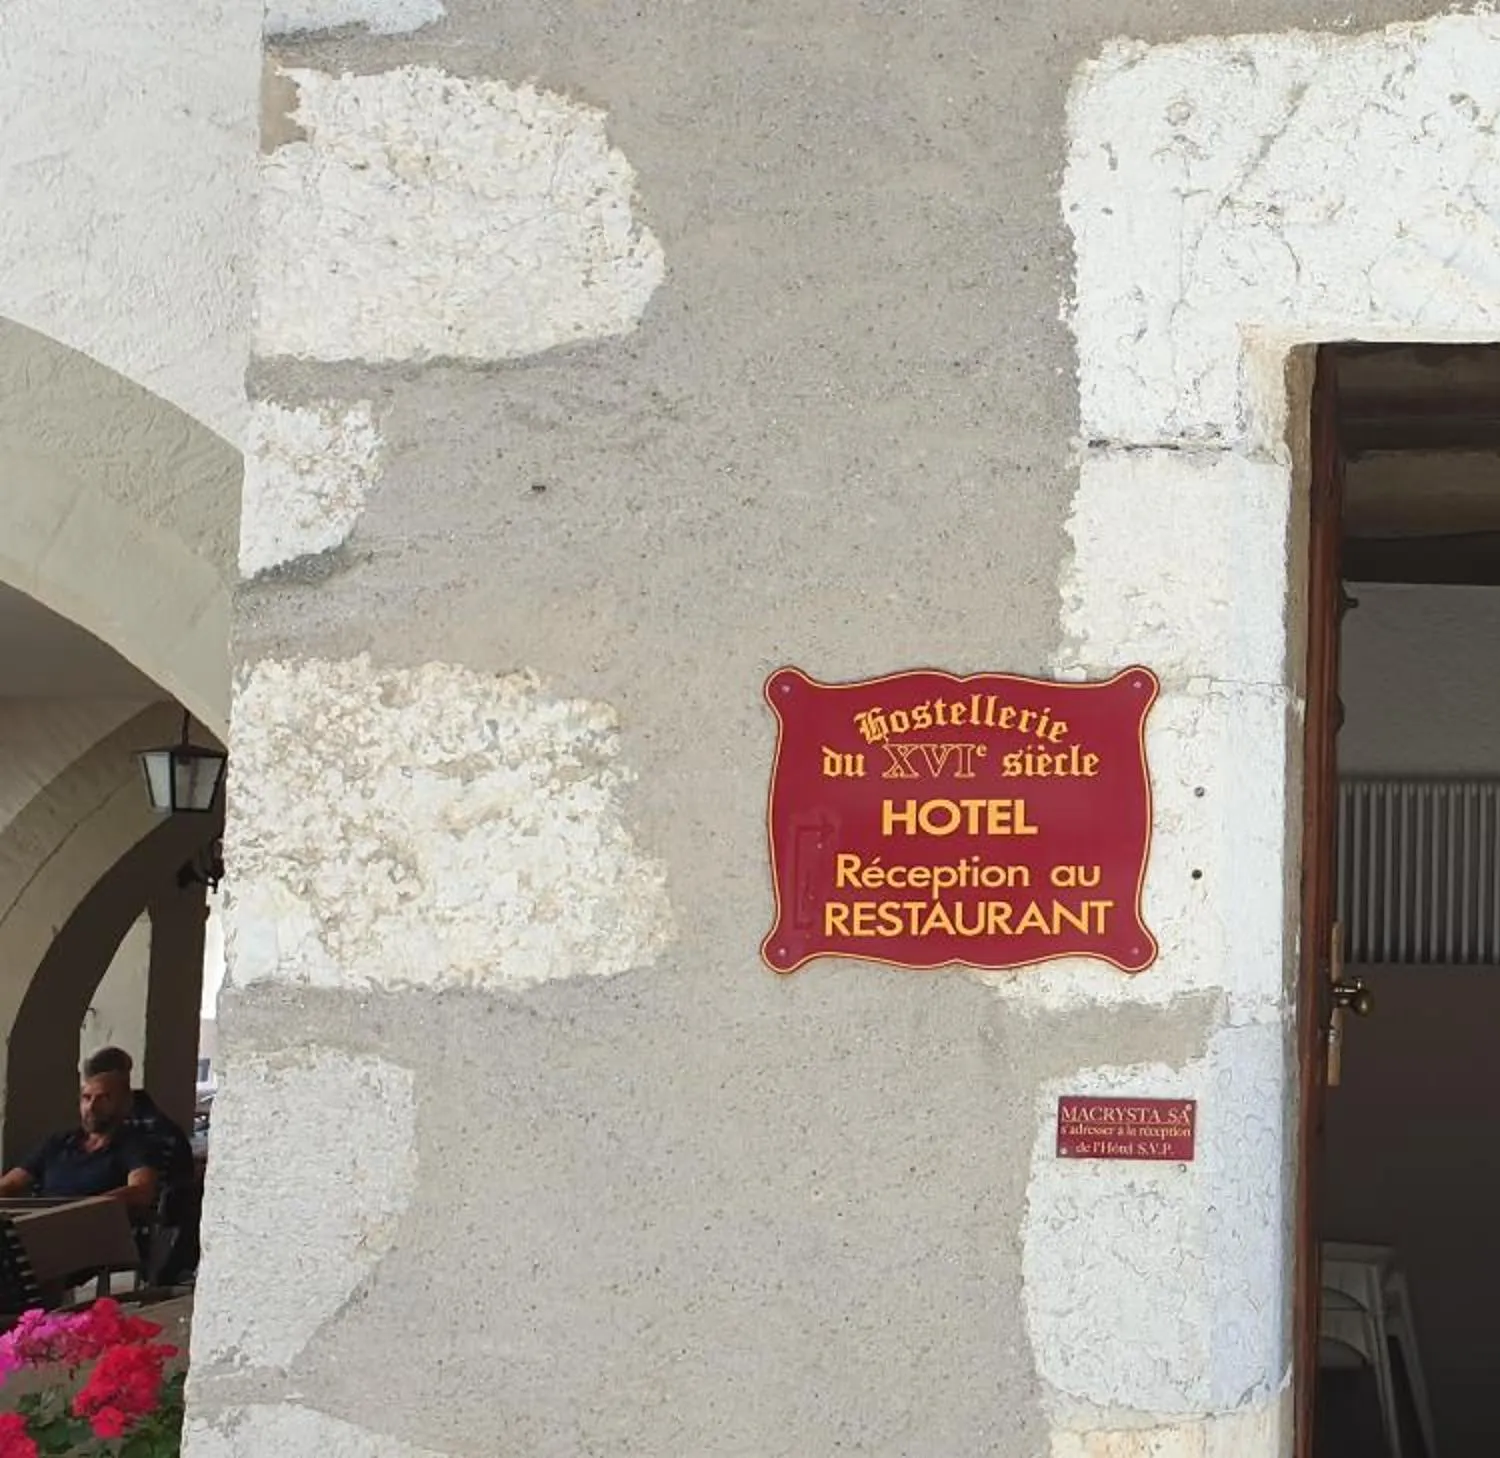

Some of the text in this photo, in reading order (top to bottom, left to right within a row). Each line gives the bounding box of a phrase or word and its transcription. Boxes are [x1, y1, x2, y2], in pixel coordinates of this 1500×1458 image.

[853, 694, 1069, 744] Hostellerie
[821, 746, 866, 778] du
[1001, 744, 1100, 778] siècle
[881, 798, 1039, 835] HOTEL
[836, 853, 1101, 900] Réception au
[824, 899, 1113, 937] RESTAURANT
[1061, 1105, 1161, 1122] MACRYSTA
